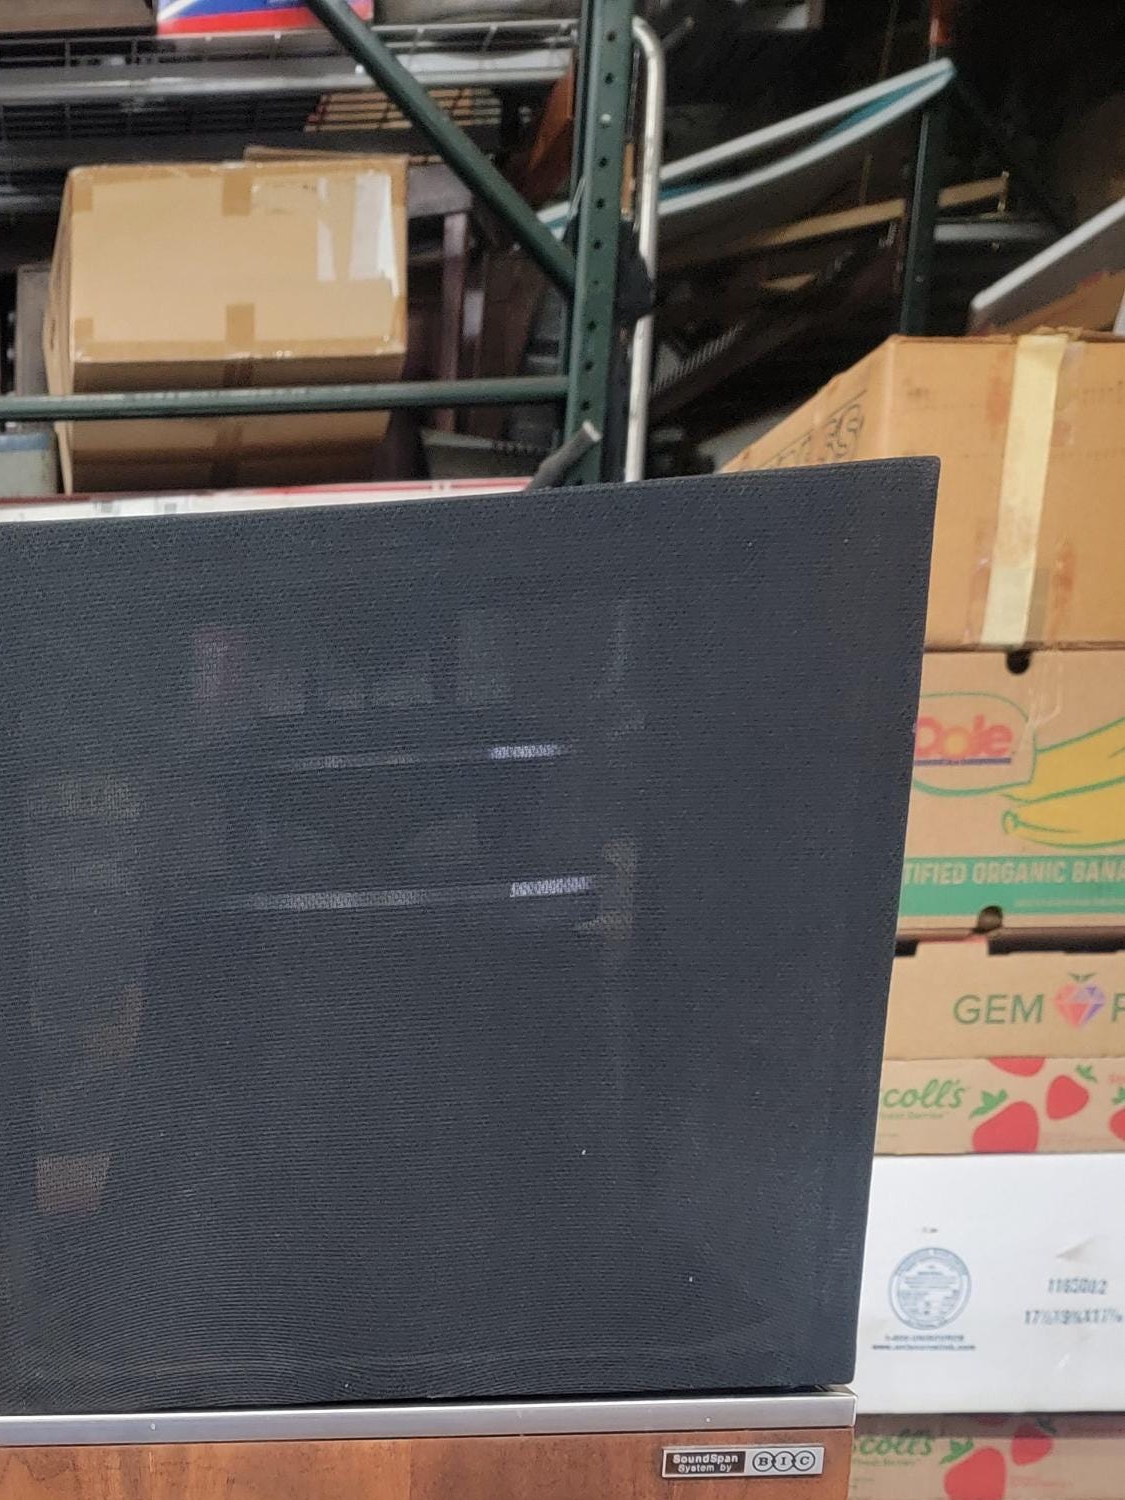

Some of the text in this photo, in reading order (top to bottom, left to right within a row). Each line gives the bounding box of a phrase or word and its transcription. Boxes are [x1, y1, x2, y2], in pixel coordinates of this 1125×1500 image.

[972, 861, 1067, 884] ORGANIC
[953, 993, 1045, 1025] GEM
[678, 1463, 732, 1473] System by
[755, 1453, 812, 1469] BIC
